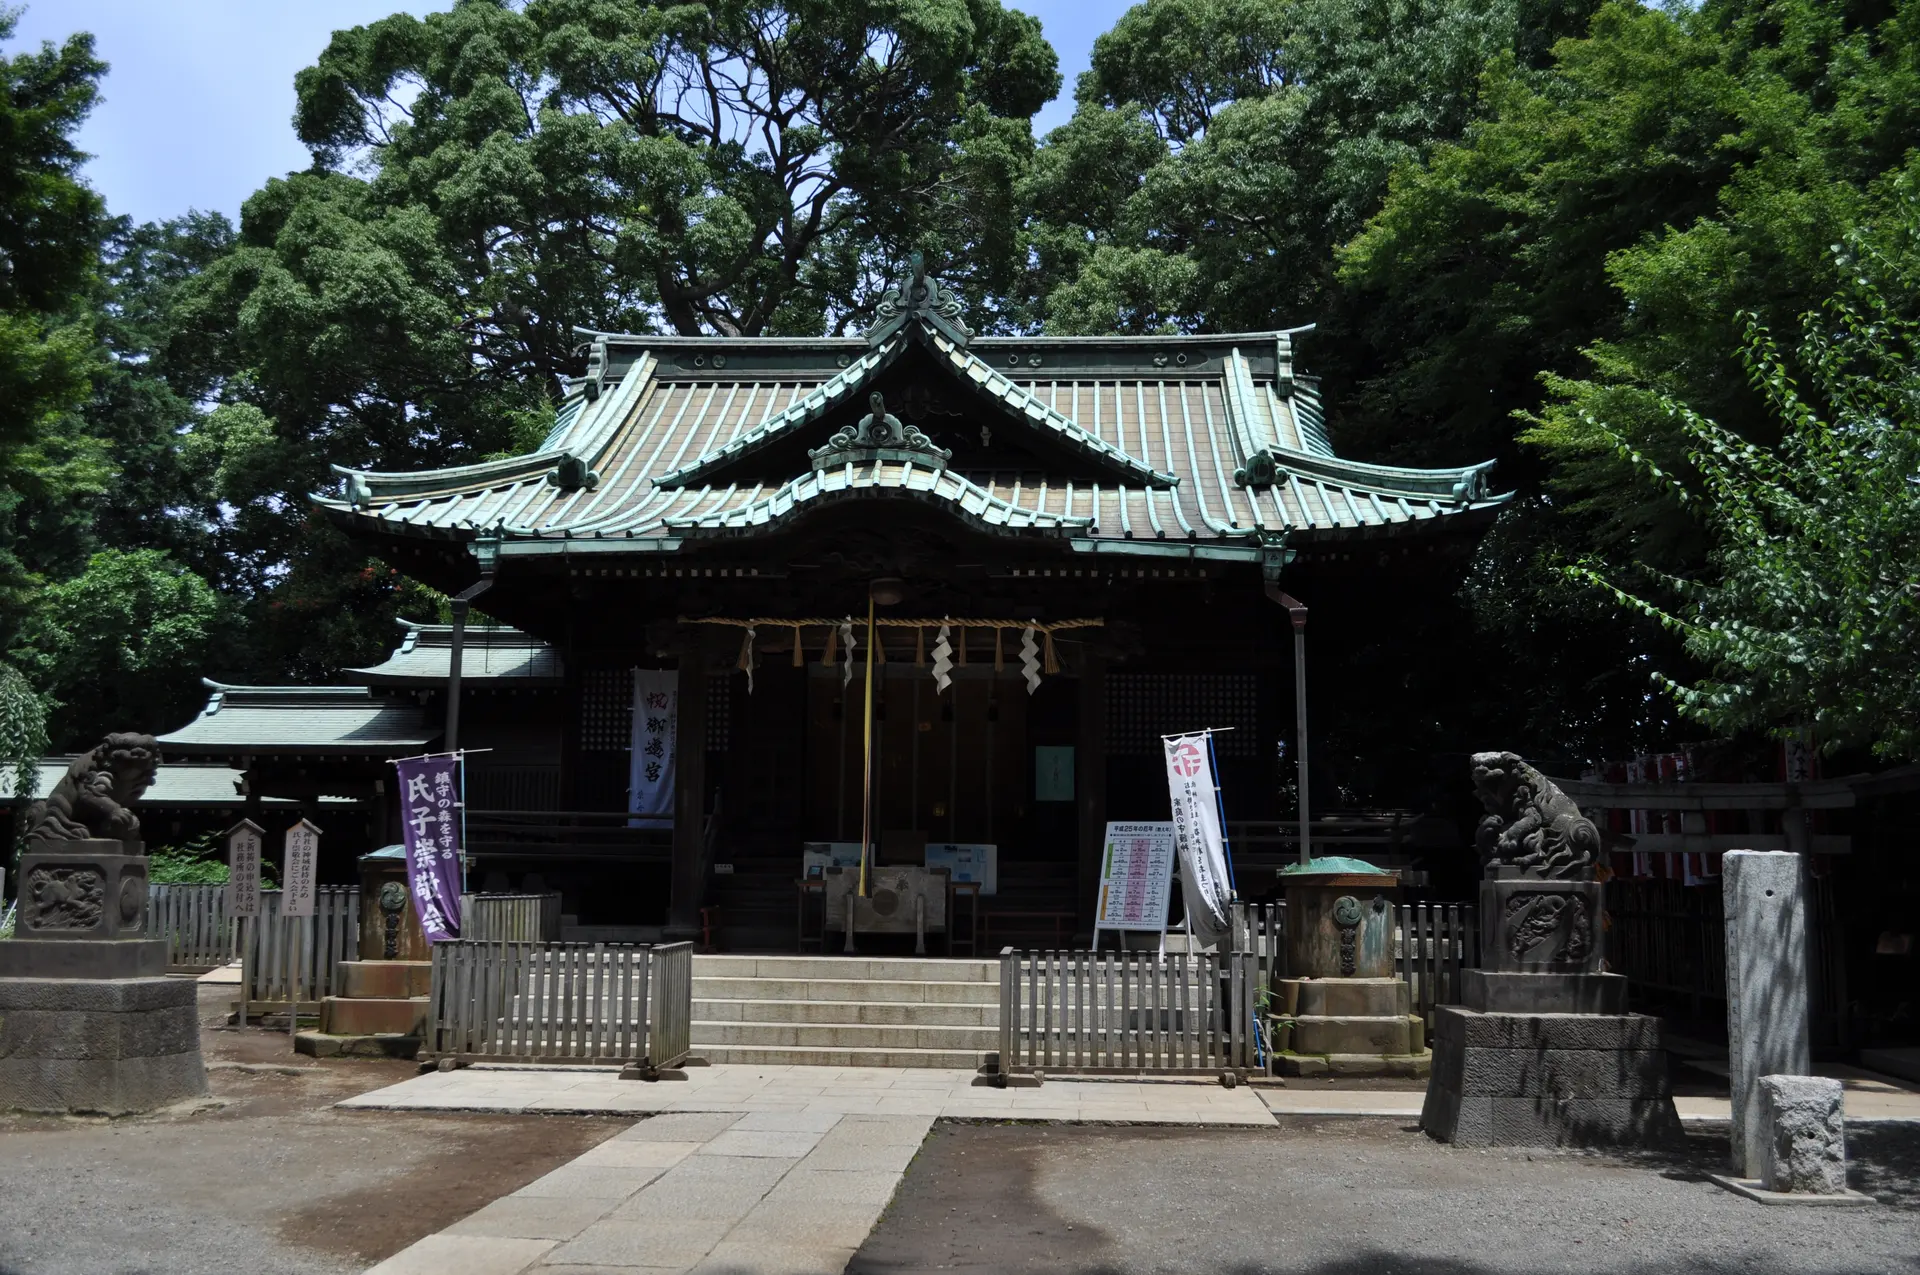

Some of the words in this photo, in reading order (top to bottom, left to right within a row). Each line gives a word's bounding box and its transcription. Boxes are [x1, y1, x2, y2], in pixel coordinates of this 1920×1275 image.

[407, 773, 446, 934] 氏子崇敬会
[435, 771, 453, 860] 鎮守の森を守る
[235, 842, 245, 912] 社務所の受付へ
